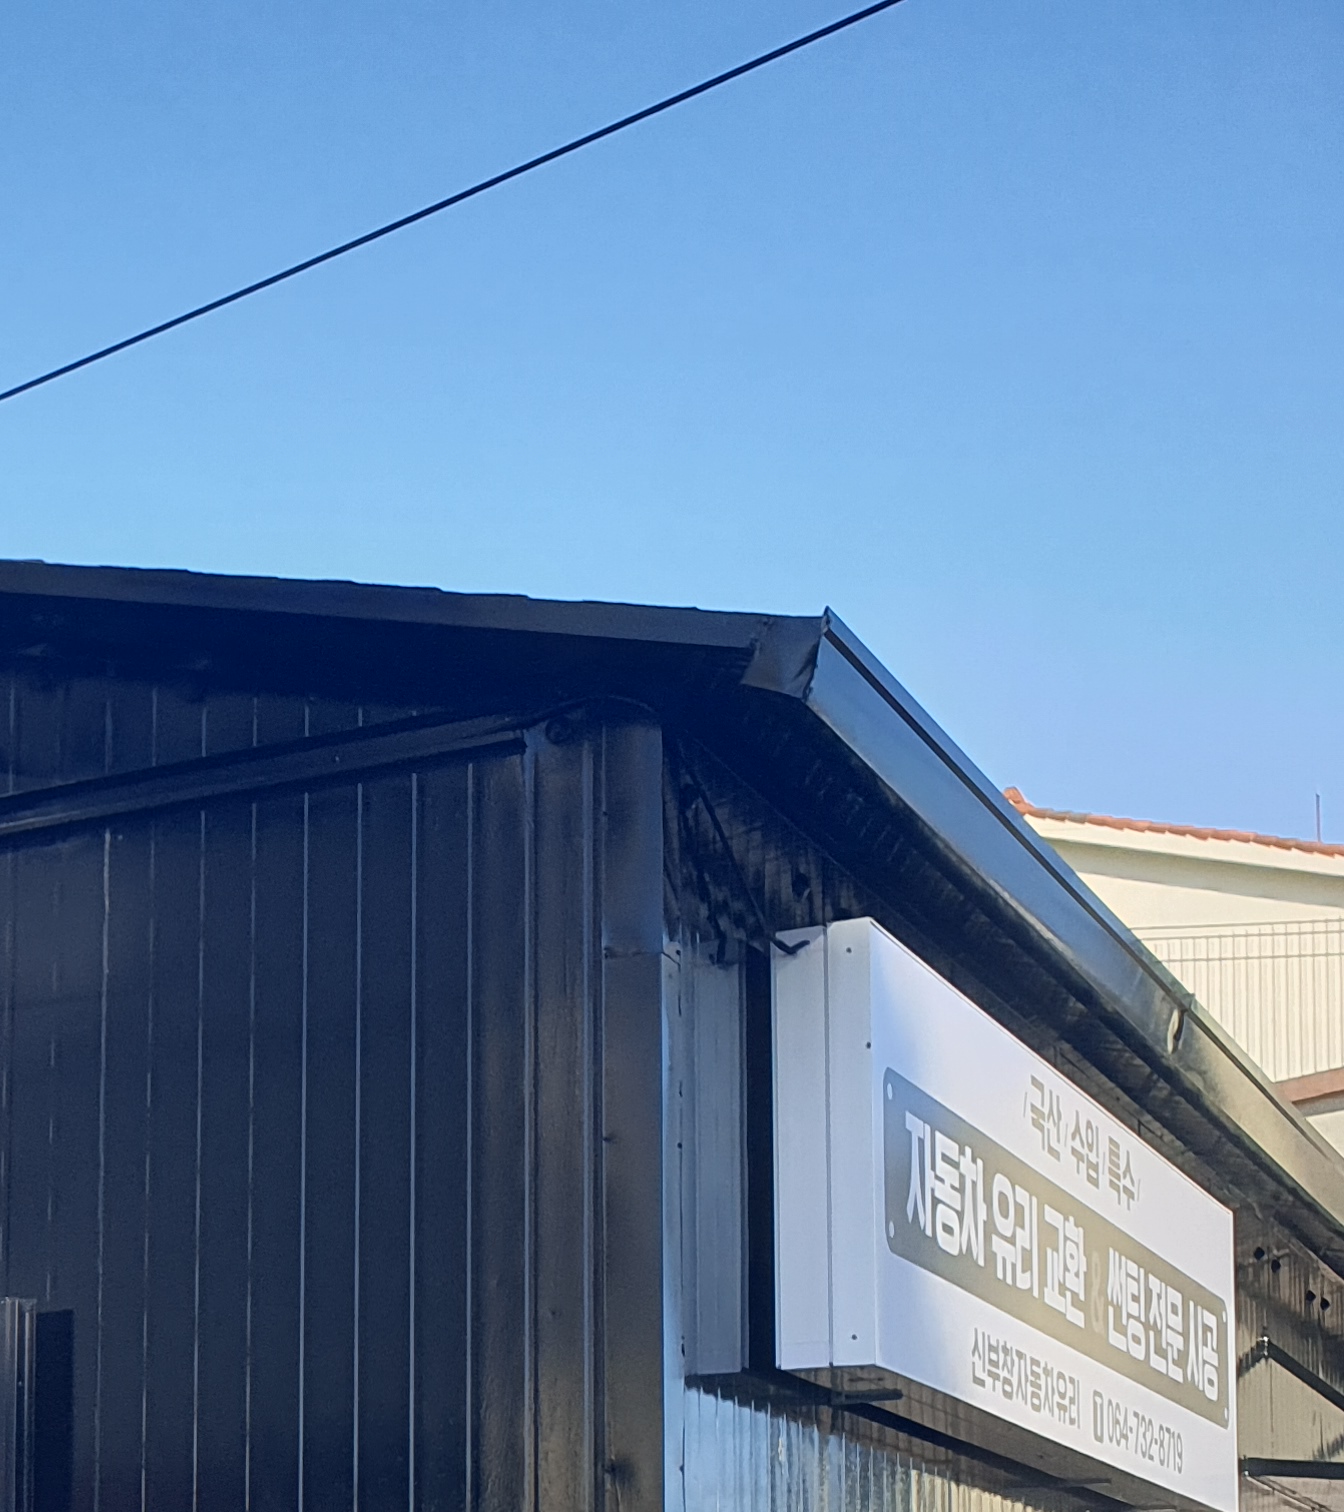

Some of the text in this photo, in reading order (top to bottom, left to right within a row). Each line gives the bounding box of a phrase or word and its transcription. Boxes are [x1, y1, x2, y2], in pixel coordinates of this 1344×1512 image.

[904, 1109, 987, 1267] 자동차
[992, 1172, 1038, 1299] 유리
[1044, 1203, 1087, 1328] 교환
[1106, 1247, 1147, 1363] 썬팅
[1148, 1279, 1184, 1383] 전문
[1187, 1300, 1220, 1403] 시공
[970, 1326, 1080, 1430] 신부창자동차유리
[1107, 1397, 1183, 1475] 064-732-8719
